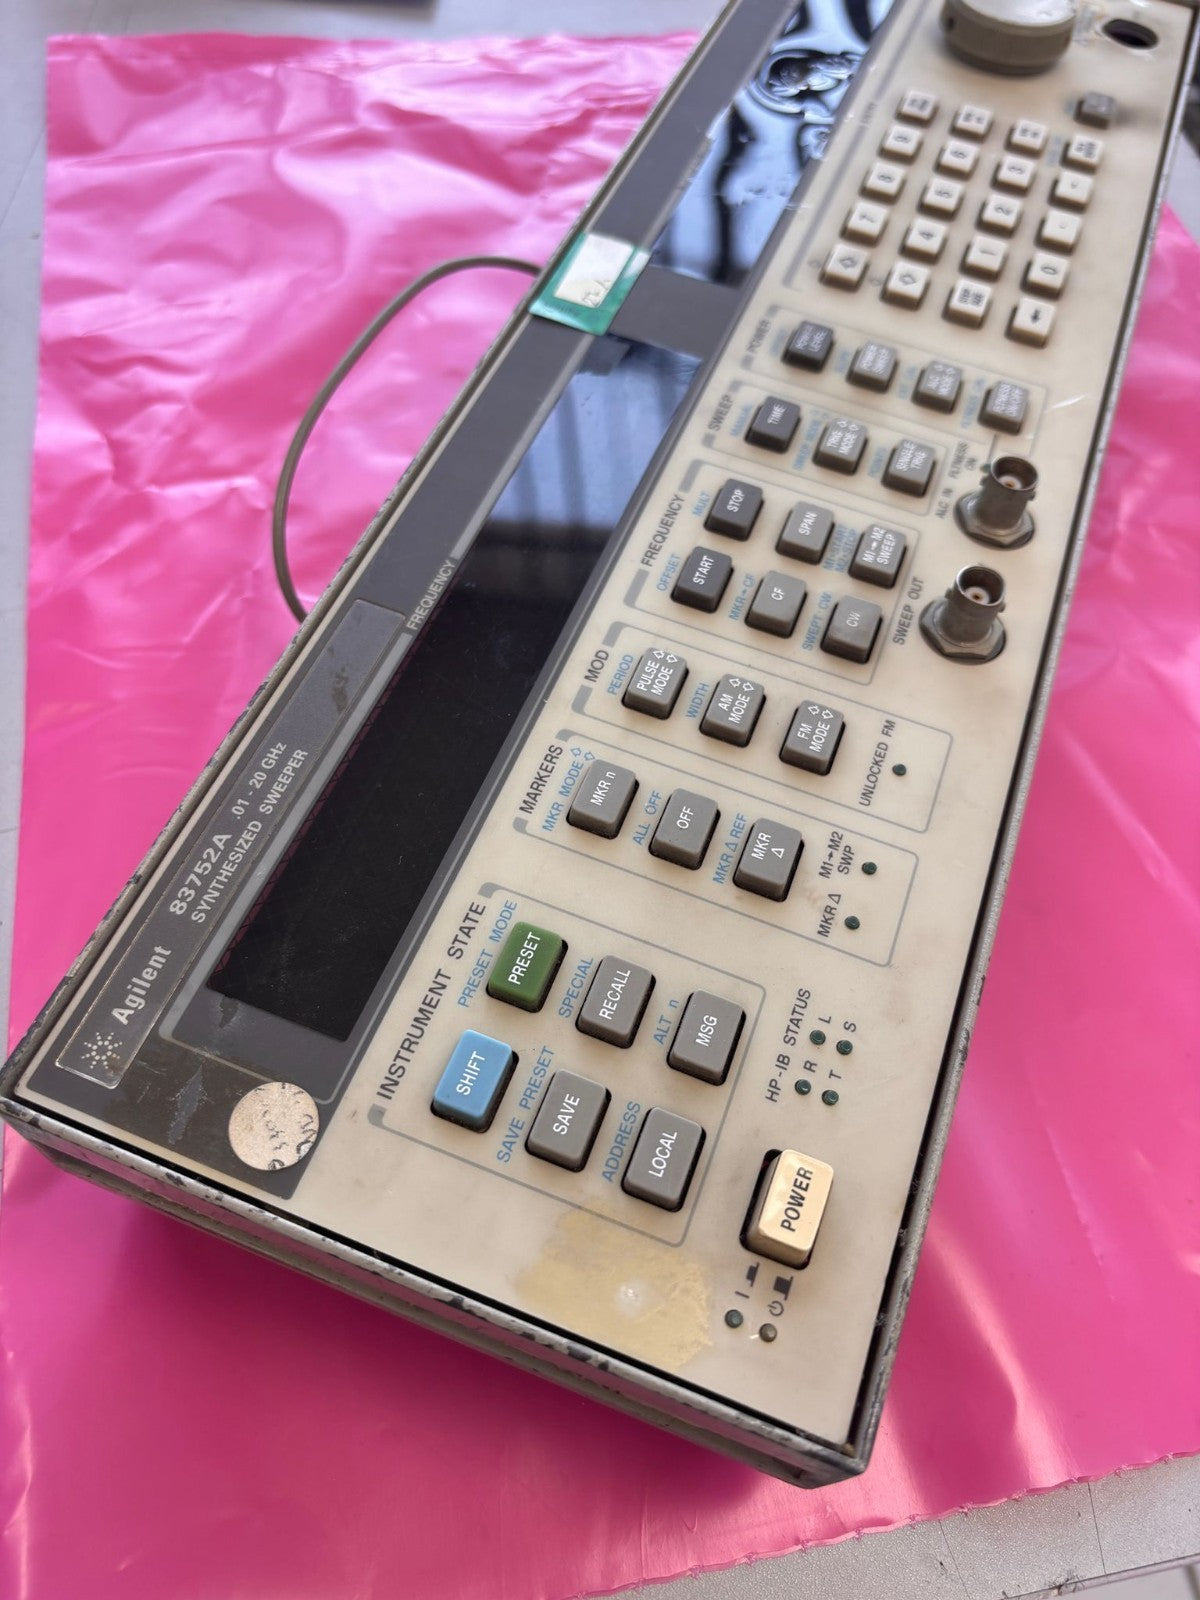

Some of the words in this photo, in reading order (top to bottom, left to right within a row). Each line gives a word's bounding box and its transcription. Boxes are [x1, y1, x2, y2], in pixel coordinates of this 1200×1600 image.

[746, 320, 770, 353] POWER
[707, 394, 734, 431] SWEEP
[767, 403, 787, 425] TIME
[838, 432, 858, 455] MODE
[896, 441, 916, 471] SINGLE
[727, 488, 745, 513] STOP
[942, 488, 953, 497] IN
[640, 494, 685, 567] FREQUENCY
[798, 511, 818, 536] SPAN
[876, 534, 896, 565] SWEEP
[656, 555, 681, 592] OFFSET
[693, 555, 715, 585] START
[407, 561, 456, 629] FREQUENCY
[771, 586, 784, 601] CF
[893, 604, 915, 646] SWEEP
[908, 576, 925, 600] OUT
[802, 613, 822, 651] SWEPT
[819, 592, 833, 609] CW
[846, 611, 861, 627] CW
[585, 649, 609, 684] MOD
[607, 654, 634, 695] PERIOD
[637, 660, 660, 692] PULSE
[651, 666, 674, 696] MODE
[686, 682, 710, 720] WIDTH
[718, 693, 732, 711] AM
[729, 693, 751, 725] MODE
[797, 722, 813, 741] FM
[809, 722, 831, 753] MODE
[232, 798, 250, 820] .01
[250, 770, 267, 791] 20
[262, 741, 287, 770] GHz
[519, 745, 564, 815] MARKERS
[859, 741, 889, 808] UNLOCKED
[880, 719, 897, 739] FM
[541, 802, 565, 833] MKR
[559, 760, 584, 799] MODE
[589, 780, 612, 807] MKR
[607, 770, 617, 781] n
[190, 820, 263, 925] SYNTHESIZED
[259, 748, 309, 815] SWEEPER
[632, 823, 651, 846] ALL
[644, 790, 662, 816] OFF
[677, 806, 695, 830] OFF
[713, 854, 733, 885] MKR
[732, 812, 748, 840] REF
[751, 831, 772, 860] MKR
[838, 844, 856, 876] SWP
[169, 831, 233, 916] 83752A
[817, 908, 838, 939] MKR
[457, 948, 494, 1008] PRESET
[489, 899, 517, 943] MODE
[508, 931, 540, 985] PRESET
[111, 945, 172, 1026] Agilent
[376, 967, 452, 1101] INSTRUMENT
[447, 901, 486, 961] STATE
[558, 956, 594, 1019] SPECIAL
[599, 969, 631, 1020] RECALL
[653, 1015, 673, 1045] ALT
[669, 999, 680, 1009] n
[695, 1014, 718, 1047] MSG
[818, 1015, 832, 1024] L
[843, 1020, 857, 1033] S
[764, 1053, 791, 1104] HP-IB
[783, 987, 811, 1047] STATUS
[456, 1050, 486, 1096] SHIFT
[803, 1060, 818, 1074] R
[829, 1069, 843, 1081] T
[496, 1116, 525, 1164] SAVE
[519, 1045, 555, 1110] PRESET
[552, 1093, 580, 1135] SAVE
[602, 1100, 641, 1184] ADDRESS
[648, 1130, 678, 1178] LOCAL
[780, 1166, 814, 1232] POWER
